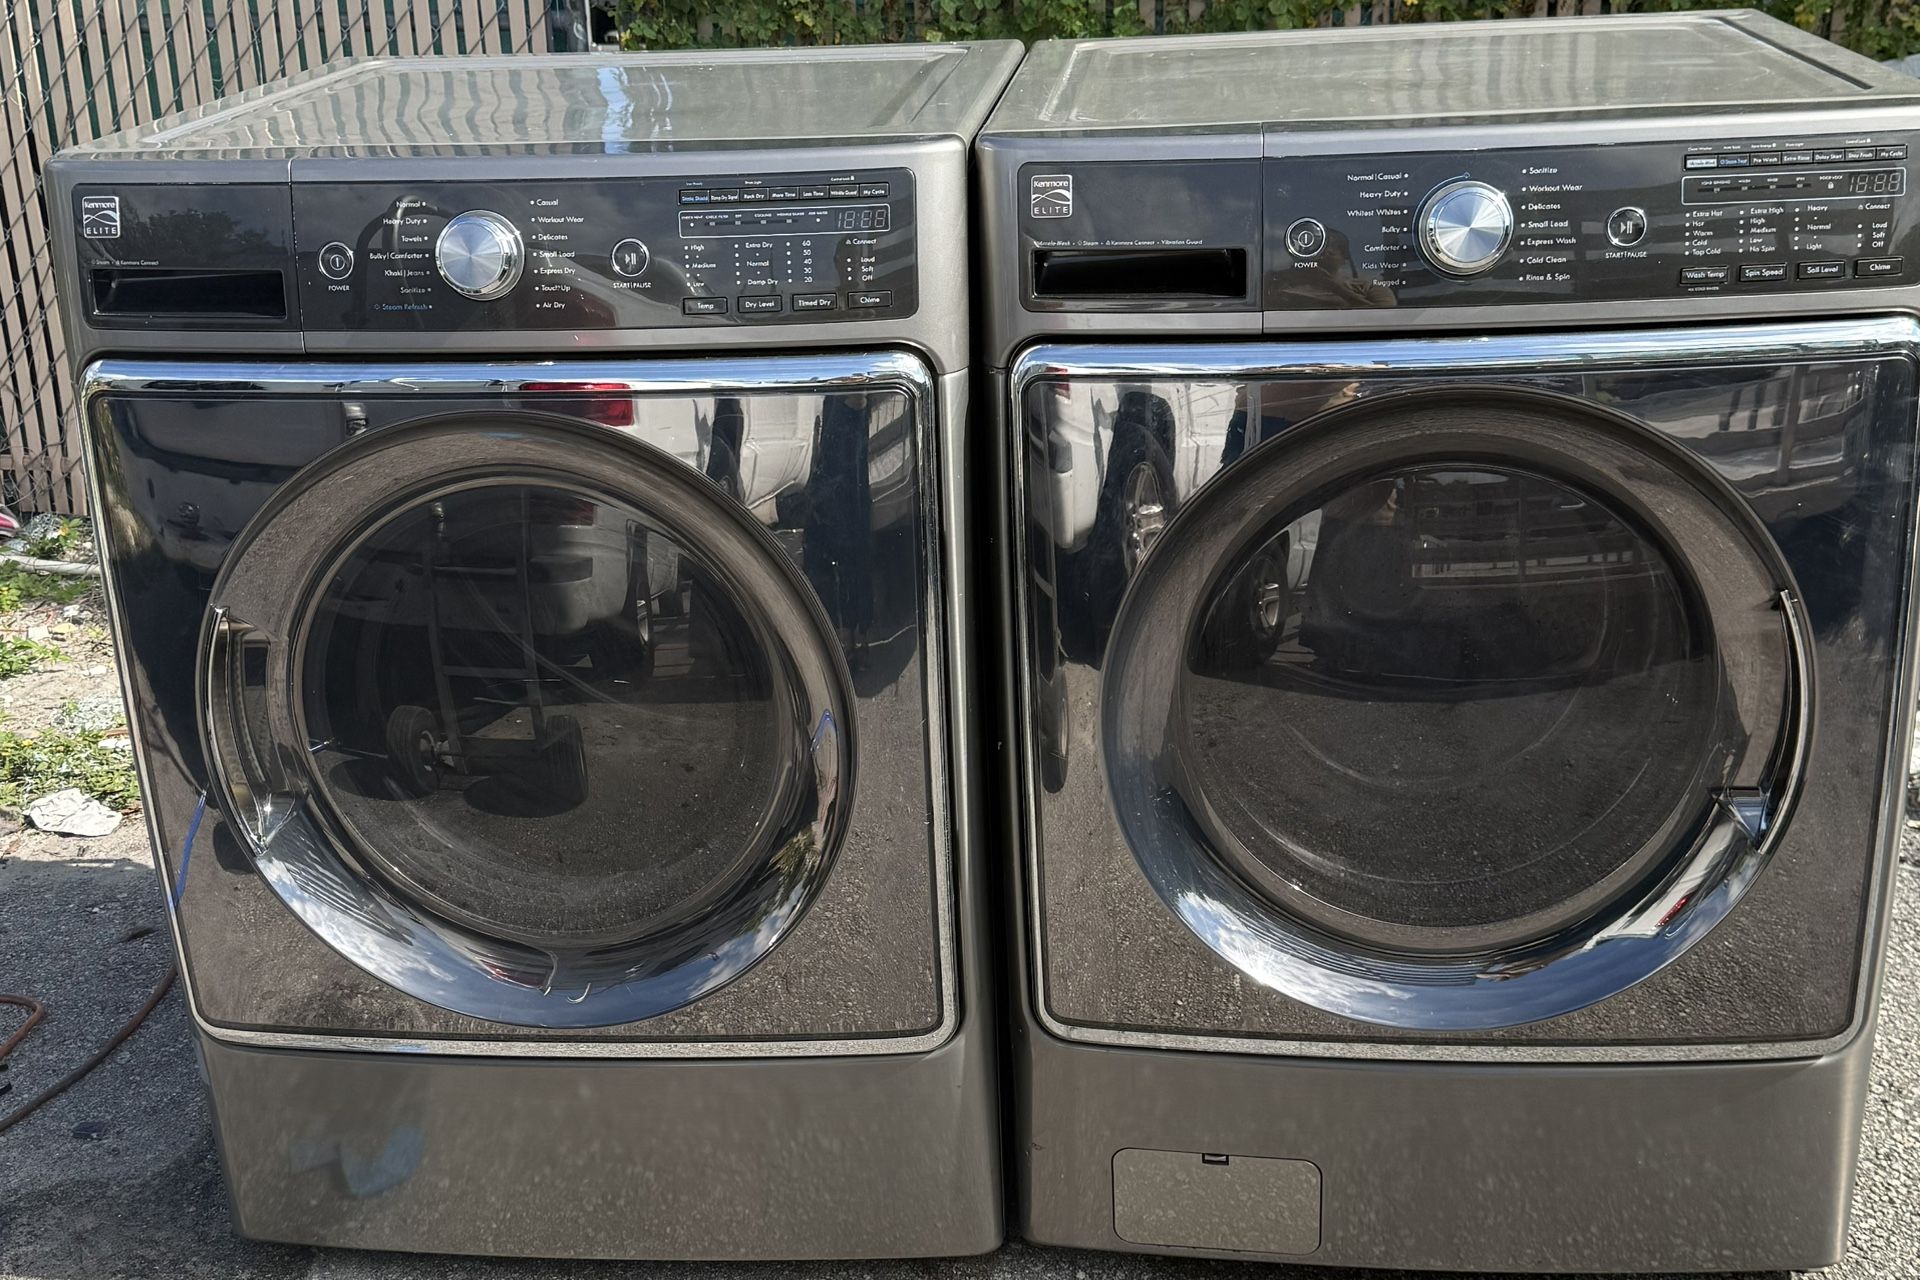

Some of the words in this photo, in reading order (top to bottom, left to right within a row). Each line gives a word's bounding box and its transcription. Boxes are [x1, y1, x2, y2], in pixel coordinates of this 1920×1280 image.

[1745, 269, 1760, 277] Spin
[1762, 268, 1783, 276] Speed
[1555, 274, 1570, 282] Spin
